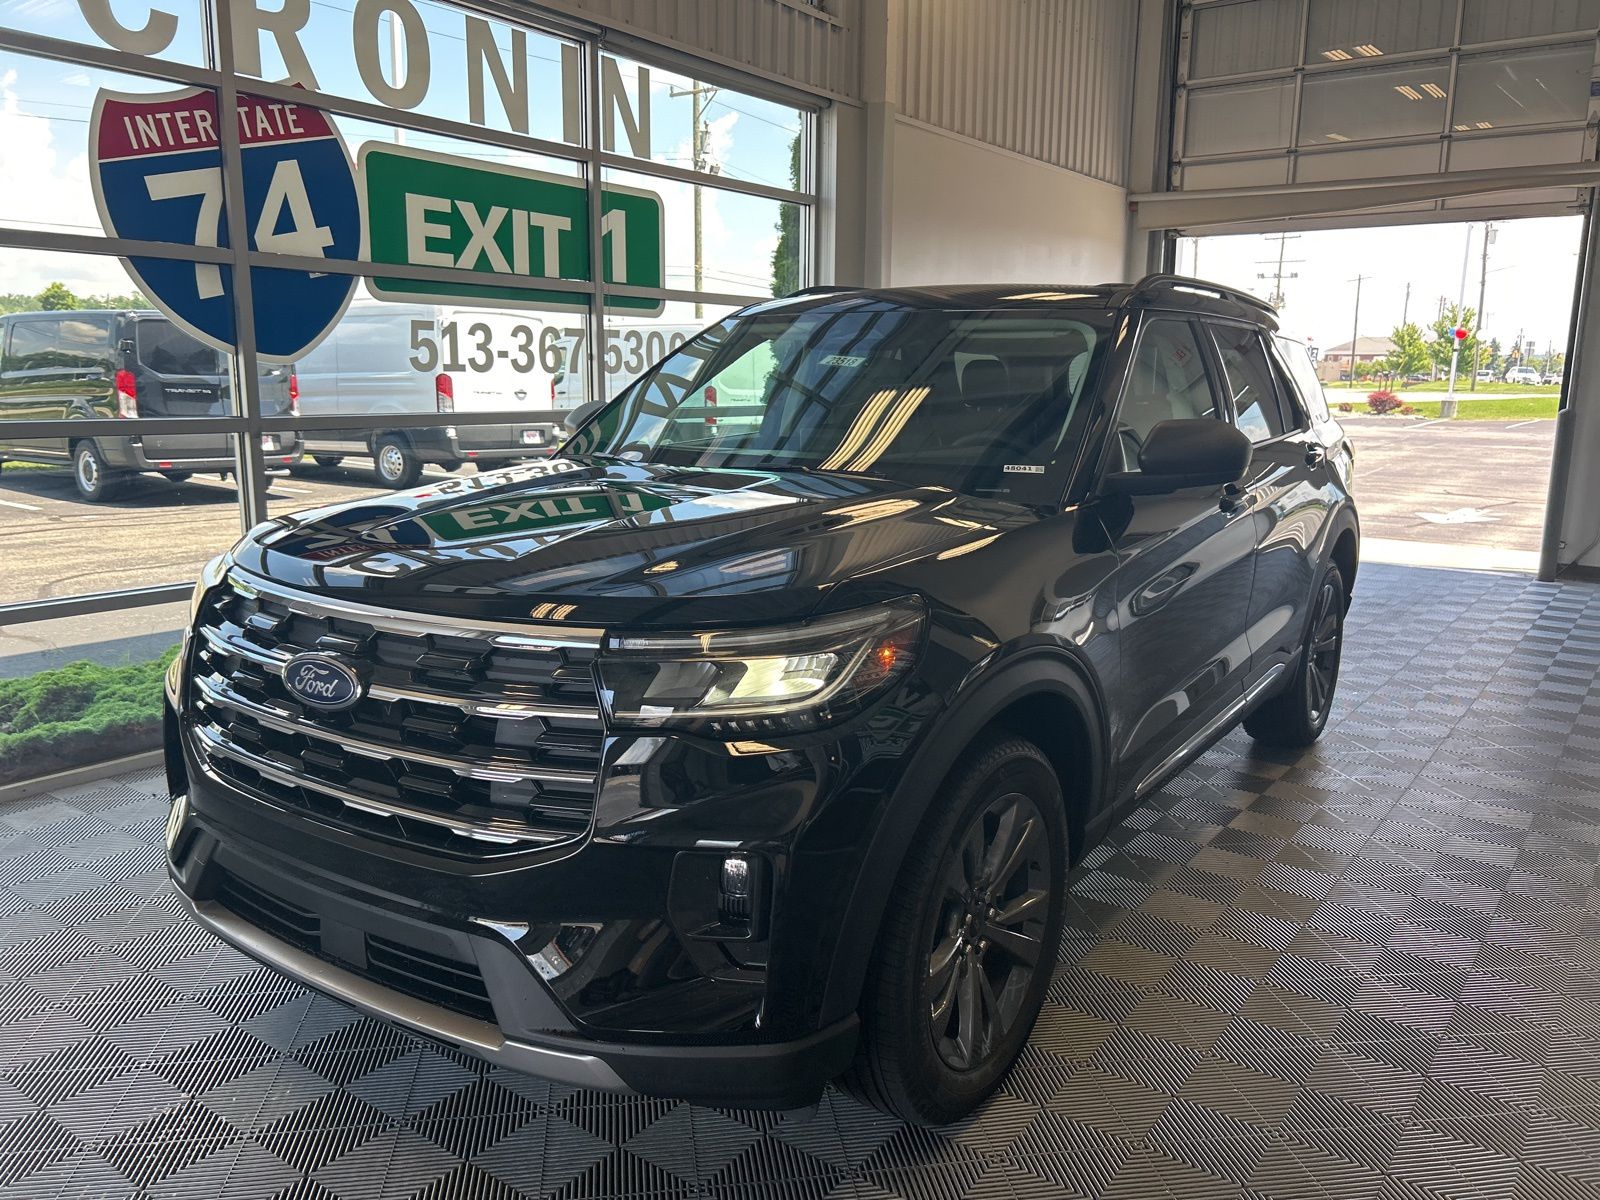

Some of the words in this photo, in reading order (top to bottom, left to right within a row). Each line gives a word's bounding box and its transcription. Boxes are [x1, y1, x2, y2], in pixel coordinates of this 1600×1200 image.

[123, 103, 305, 150] INTERTATE
[143, 159, 335, 300] 74
[405, 192, 572, 279] EXIT
[601, 208, 627, 284] 1
[408, 320, 687, 375] 513-367530
[295, 664, 339, 698] Ford
